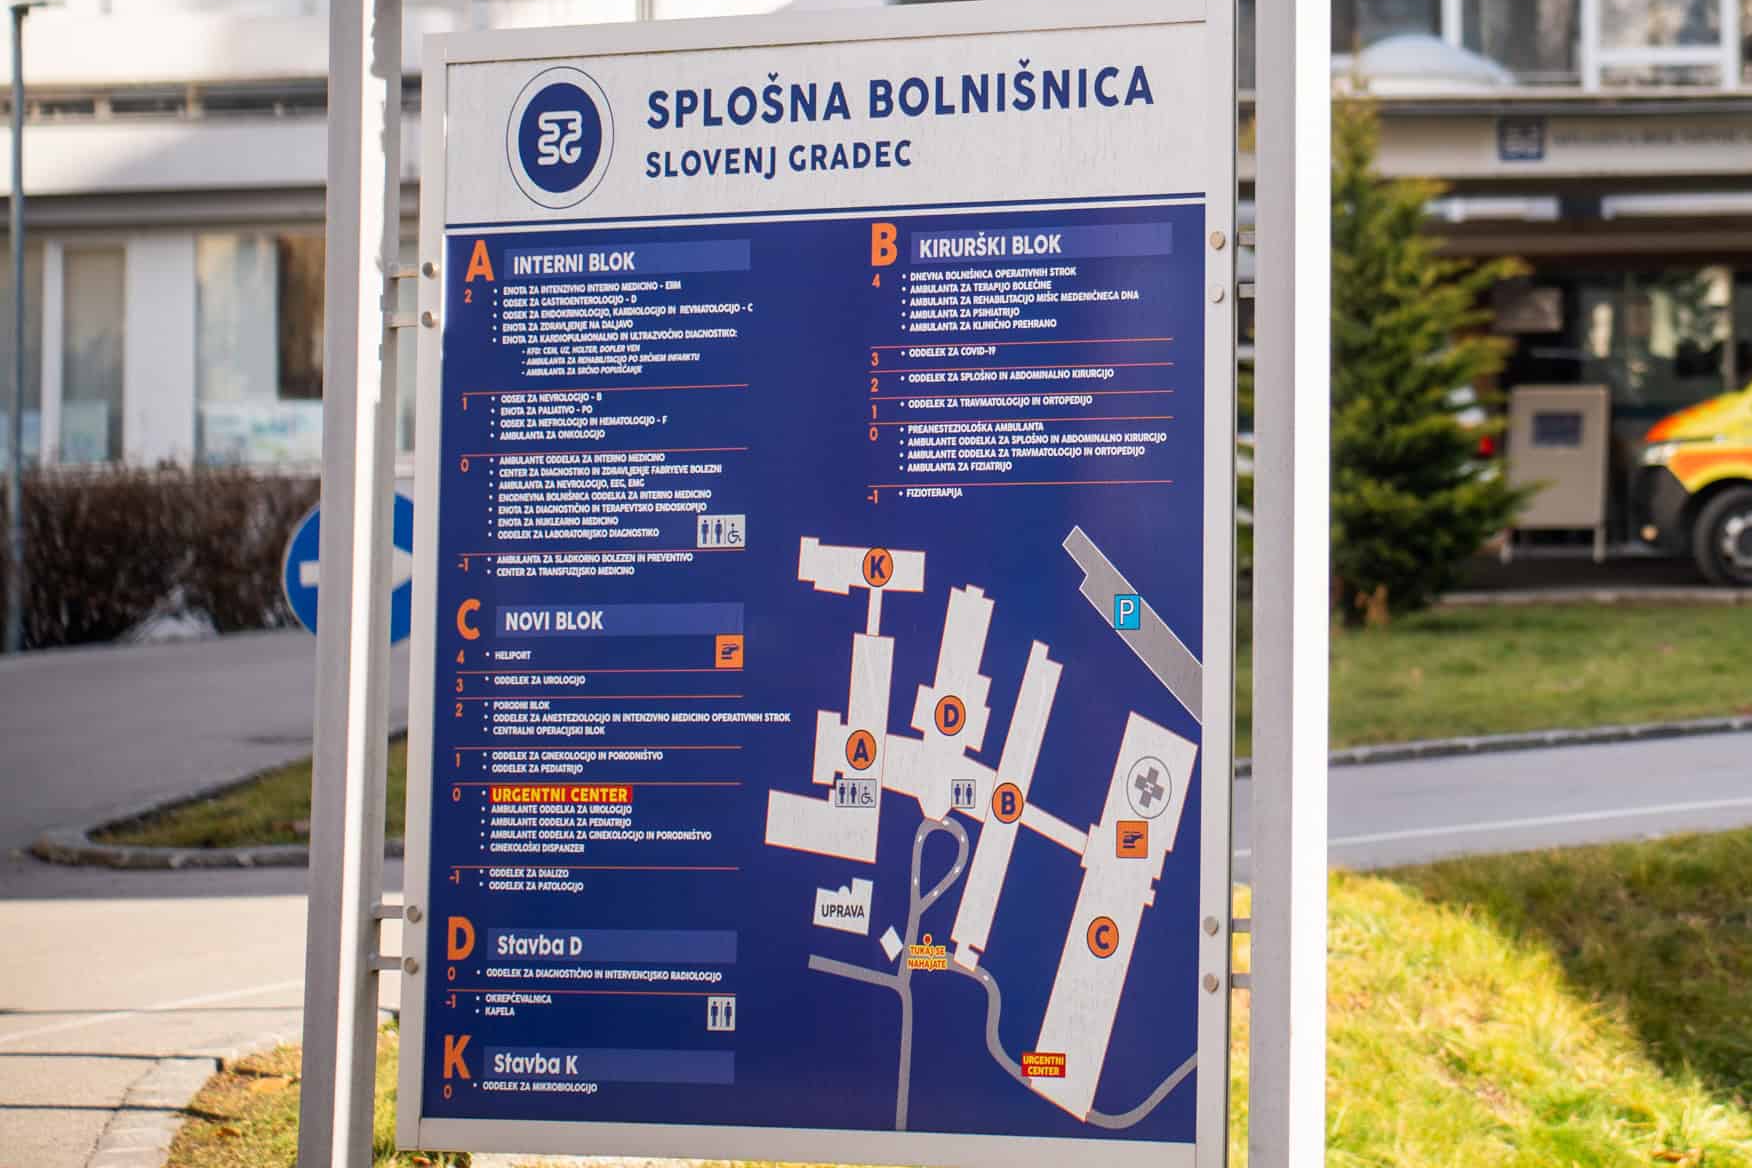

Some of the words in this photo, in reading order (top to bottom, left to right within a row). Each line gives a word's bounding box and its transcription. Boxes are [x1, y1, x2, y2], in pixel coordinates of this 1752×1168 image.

[648, 73, 850, 129] SPLOŠNA
[870, 59, 1153, 118] BOLNIŠNICA
[646, 147, 775, 179] SLOVENJ
[789, 140, 910, 171] GRADEC
[871, 222, 898, 267] B
[920, 232, 1005, 258] KIRURŠKI
[1012, 234, 1061, 254] BLOK
[465, 240, 495, 282] A
[514, 254, 582, 274] INTERNI
[589, 252, 634, 271] BLOK
[872, 274, 880, 287] 4
[910, 271, 943, 281] DNEVNA
[1049, 267, 1076, 276] STROK
[910, 284, 958, 293] AMBULANTA
[960, 283, 971, 292] ZA
[973, 282, 1010, 293] TERAPIJO
[464, 288, 472, 303] 2
[909, 296, 958, 306] AMBULANTA
[960, 296, 971, 304] ZA
[1121, 290, 1139, 299] DNA
[909, 309, 958, 319] AMBULANTA
[959, 309, 971, 317] ZA
[909, 322, 958, 331] AMBULANTA
[959, 321, 971, 330] ZA
[1012, 319, 1056, 328] PREHRANO
[909, 348, 945, 357] ODDELEK
[960, 347, 995, 355] COVID-19
[872, 352, 879, 367] 3
[908, 373, 945, 382] ODDELEK
[947, 373, 958, 381] ZA
[999, 371, 1008, 379] IN
[1072, 368, 1114, 380] KIRURGIJO
[870, 377, 879, 393] 2
[463, 396, 467, 410] 1
[908, 399, 945, 408] ODDELEK
[947, 399, 958, 407] ZA
[1031, 397, 1040, 405] IN
[872, 404, 877, 418] 1
[869, 426, 878, 441] 0
[994, 422, 1043, 431] AMBULANTA
[907, 437, 956, 446] AMBULANTE
[958, 436, 996, 445] ODDELKA
[998, 435, 1009, 444] ZA
[1050, 435, 1059, 443] IN
[1124, 432, 1167, 443] KIRURGIJO
[460, 457, 469, 472] 0
[907, 463, 956, 471] AMBULANTA
[957, 462, 969, 470] ZA
[871, 556, 884, 578] K
[457, 598, 480, 640] C
[1121, 600, 1133, 624] P
[506, 612, 549, 630] NOVI
[556, 611, 603, 630] BLOK
[456, 650, 464, 664] 4
[456, 678, 463, 692] 3
[456, 703, 463, 717] 2
[944, 704, 959, 727] D
[853, 739, 868, 761] A
[456, 753, 460, 767] 1
[453, 787, 461, 800] 0
[493, 788, 565, 801] URGENTNI
[571, 788, 627, 802] CENTER
[1002, 792, 1015, 814] B
[822, 904, 864, 917] UPRAVA
[448, 916, 475, 960] D
[1095, 925, 1109, 950] C
[498, 935, 563, 954] Stavba
[570, 937, 582, 955] D
[909, 945, 934, 957] TUKAJ
[936, 945, 945, 956] SE
[907, 958, 947, 970] NAHAJATE
[448, 967, 455, 980] 0
[443, 1035, 470, 1079] K
[495, 1054, 559, 1074] Stavba
[566, 1056, 577, 1074] K
[1023, 1055, 1064, 1066] URGENTNI
[1028, 1066, 1060, 1077] CENTER
[444, 1085, 452, 1099] 0
